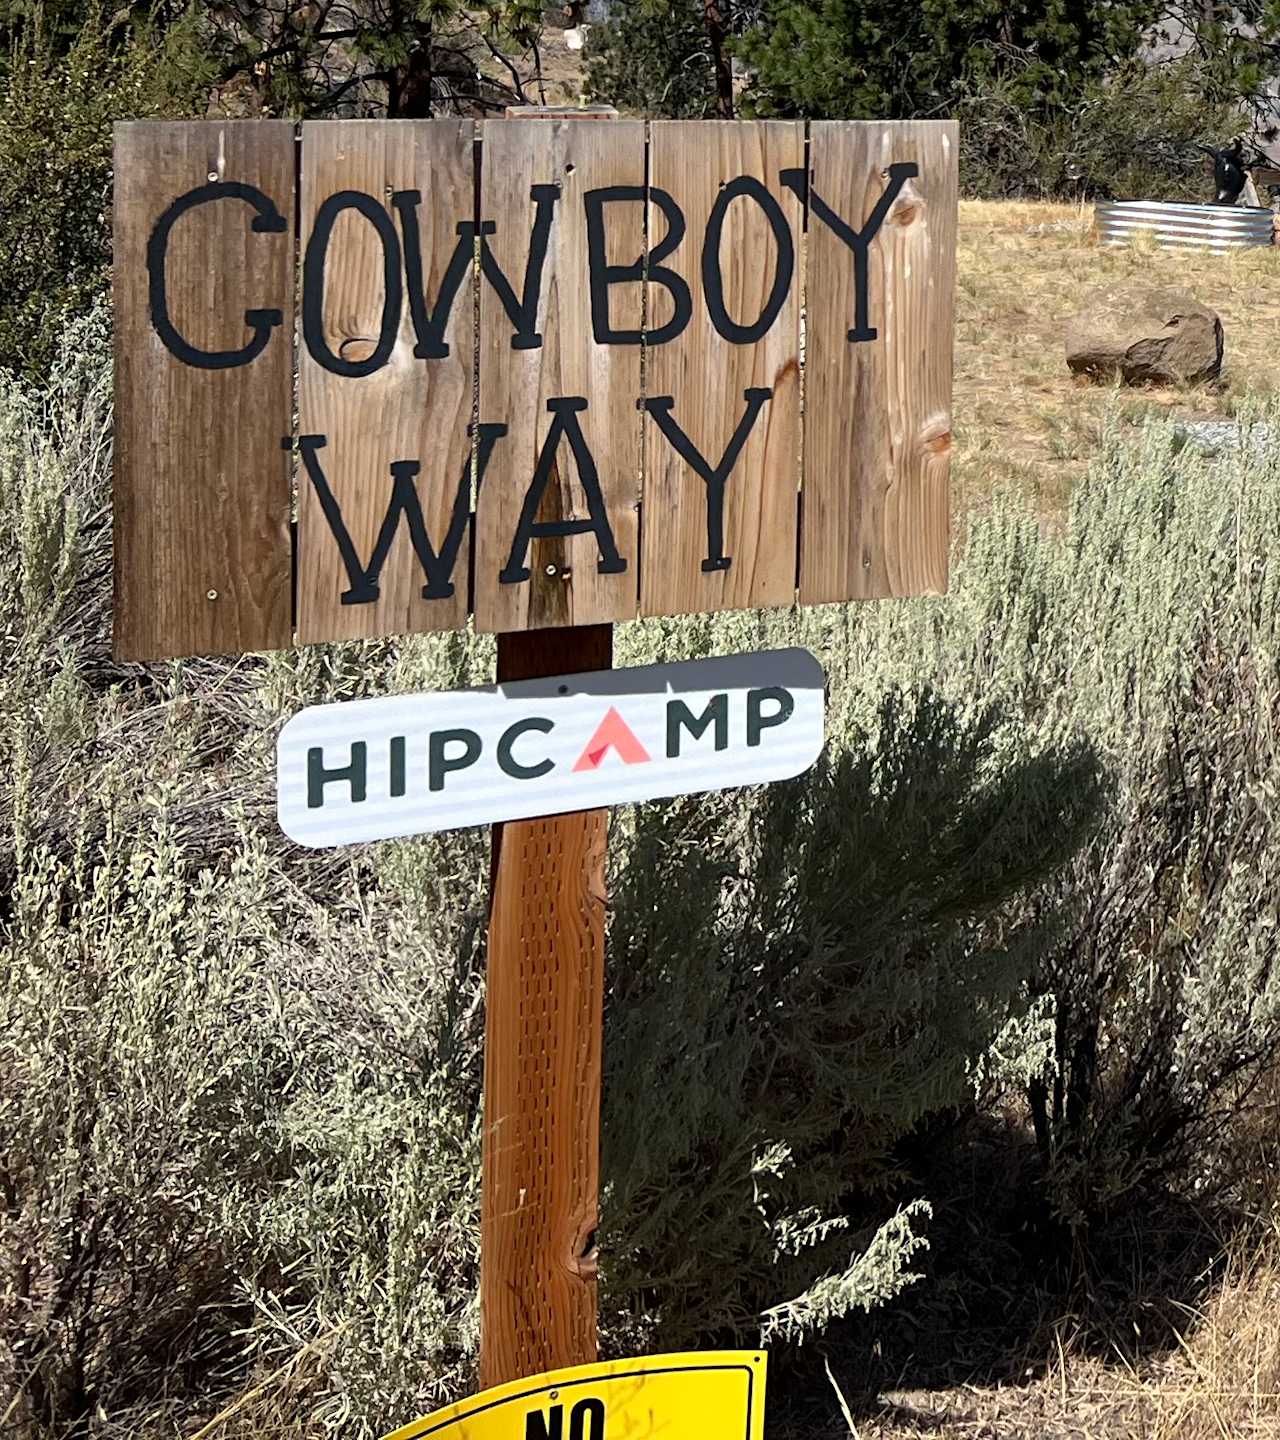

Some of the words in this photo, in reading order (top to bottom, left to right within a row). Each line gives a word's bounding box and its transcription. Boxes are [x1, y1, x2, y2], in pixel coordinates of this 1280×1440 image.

[146, 162, 918, 378] COWBOY
[281, 387, 772, 605] WAY
[306, 686, 795, 809] HIPCAMP
[525, 1398, 605, 1440] NO
